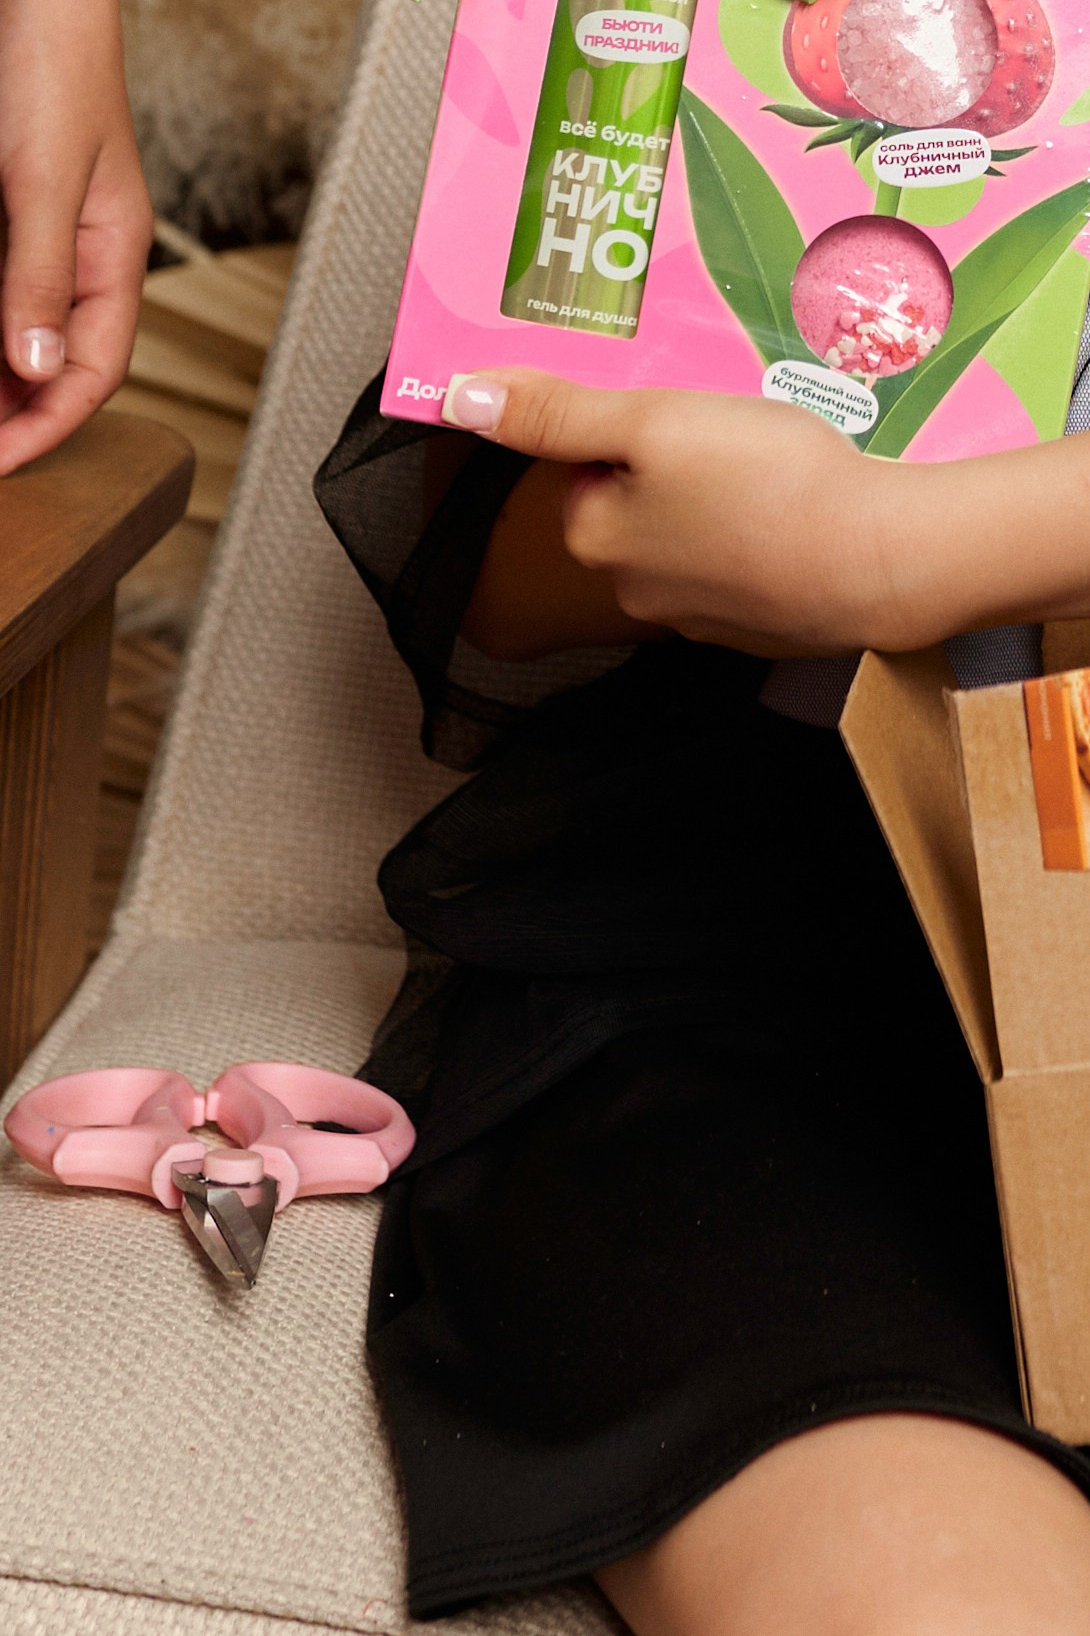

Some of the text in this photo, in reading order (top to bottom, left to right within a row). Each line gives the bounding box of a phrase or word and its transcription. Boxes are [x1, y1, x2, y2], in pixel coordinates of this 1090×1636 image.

[601, 18, 664, 35] БЬЮТИ
[583, 35, 680, 55] ПРАЗДНИК!
[559, 120, 671, 152] всё будет
[880, 138, 982, 152] соль для ванн
[552, 150, 664, 194] КЛУБ
[877, 148, 985, 166] Клубничный
[903, 163, 961, 179] джем
[546, 179, 658, 231] НИЧ
[536, 217, 650, 282] НО
[526, 298, 638, 327] гель для душа
[770, 375, 873, 422] Клубничный
[780, 367, 873, 408] бурлящий шар
